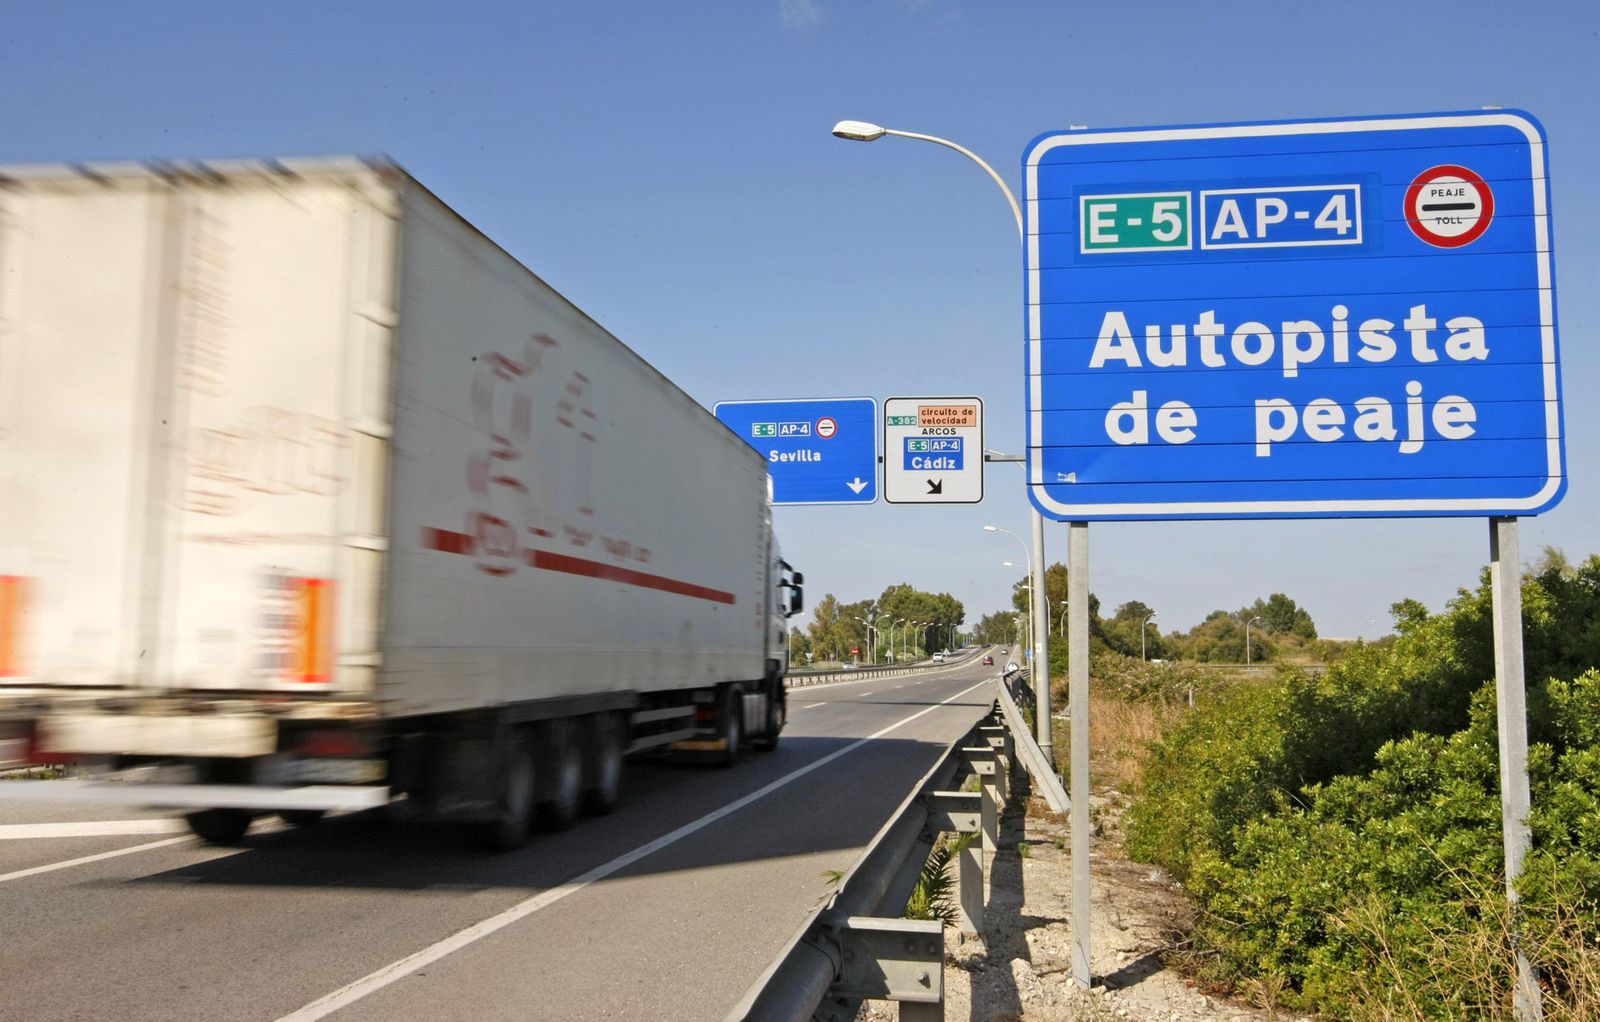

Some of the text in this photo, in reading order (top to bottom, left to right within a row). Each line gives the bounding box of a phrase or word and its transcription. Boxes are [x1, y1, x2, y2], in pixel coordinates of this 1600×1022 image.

[1431, 188, 1465, 197] PEAJE
[1089, 193, 1352, 244] E-5 AP-4
[1435, 216, 1463, 225] TOLL
[1089, 304, 1490, 378] Autopista
[921, 408, 974, 416] circuito de
[887, 416, 917, 425] A-382
[921, 417, 967, 425] velocidad
[1104, 380, 1477, 457] de peaje
[753, 423, 810, 436] E-5 AP-4
[921, 427, 957, 436] ARCOS
[909, 441, 959, 450] E-5 AP-4
[769, 450, 822, 463] Sevilla
[911, 456, 956, 469] Cádiz
